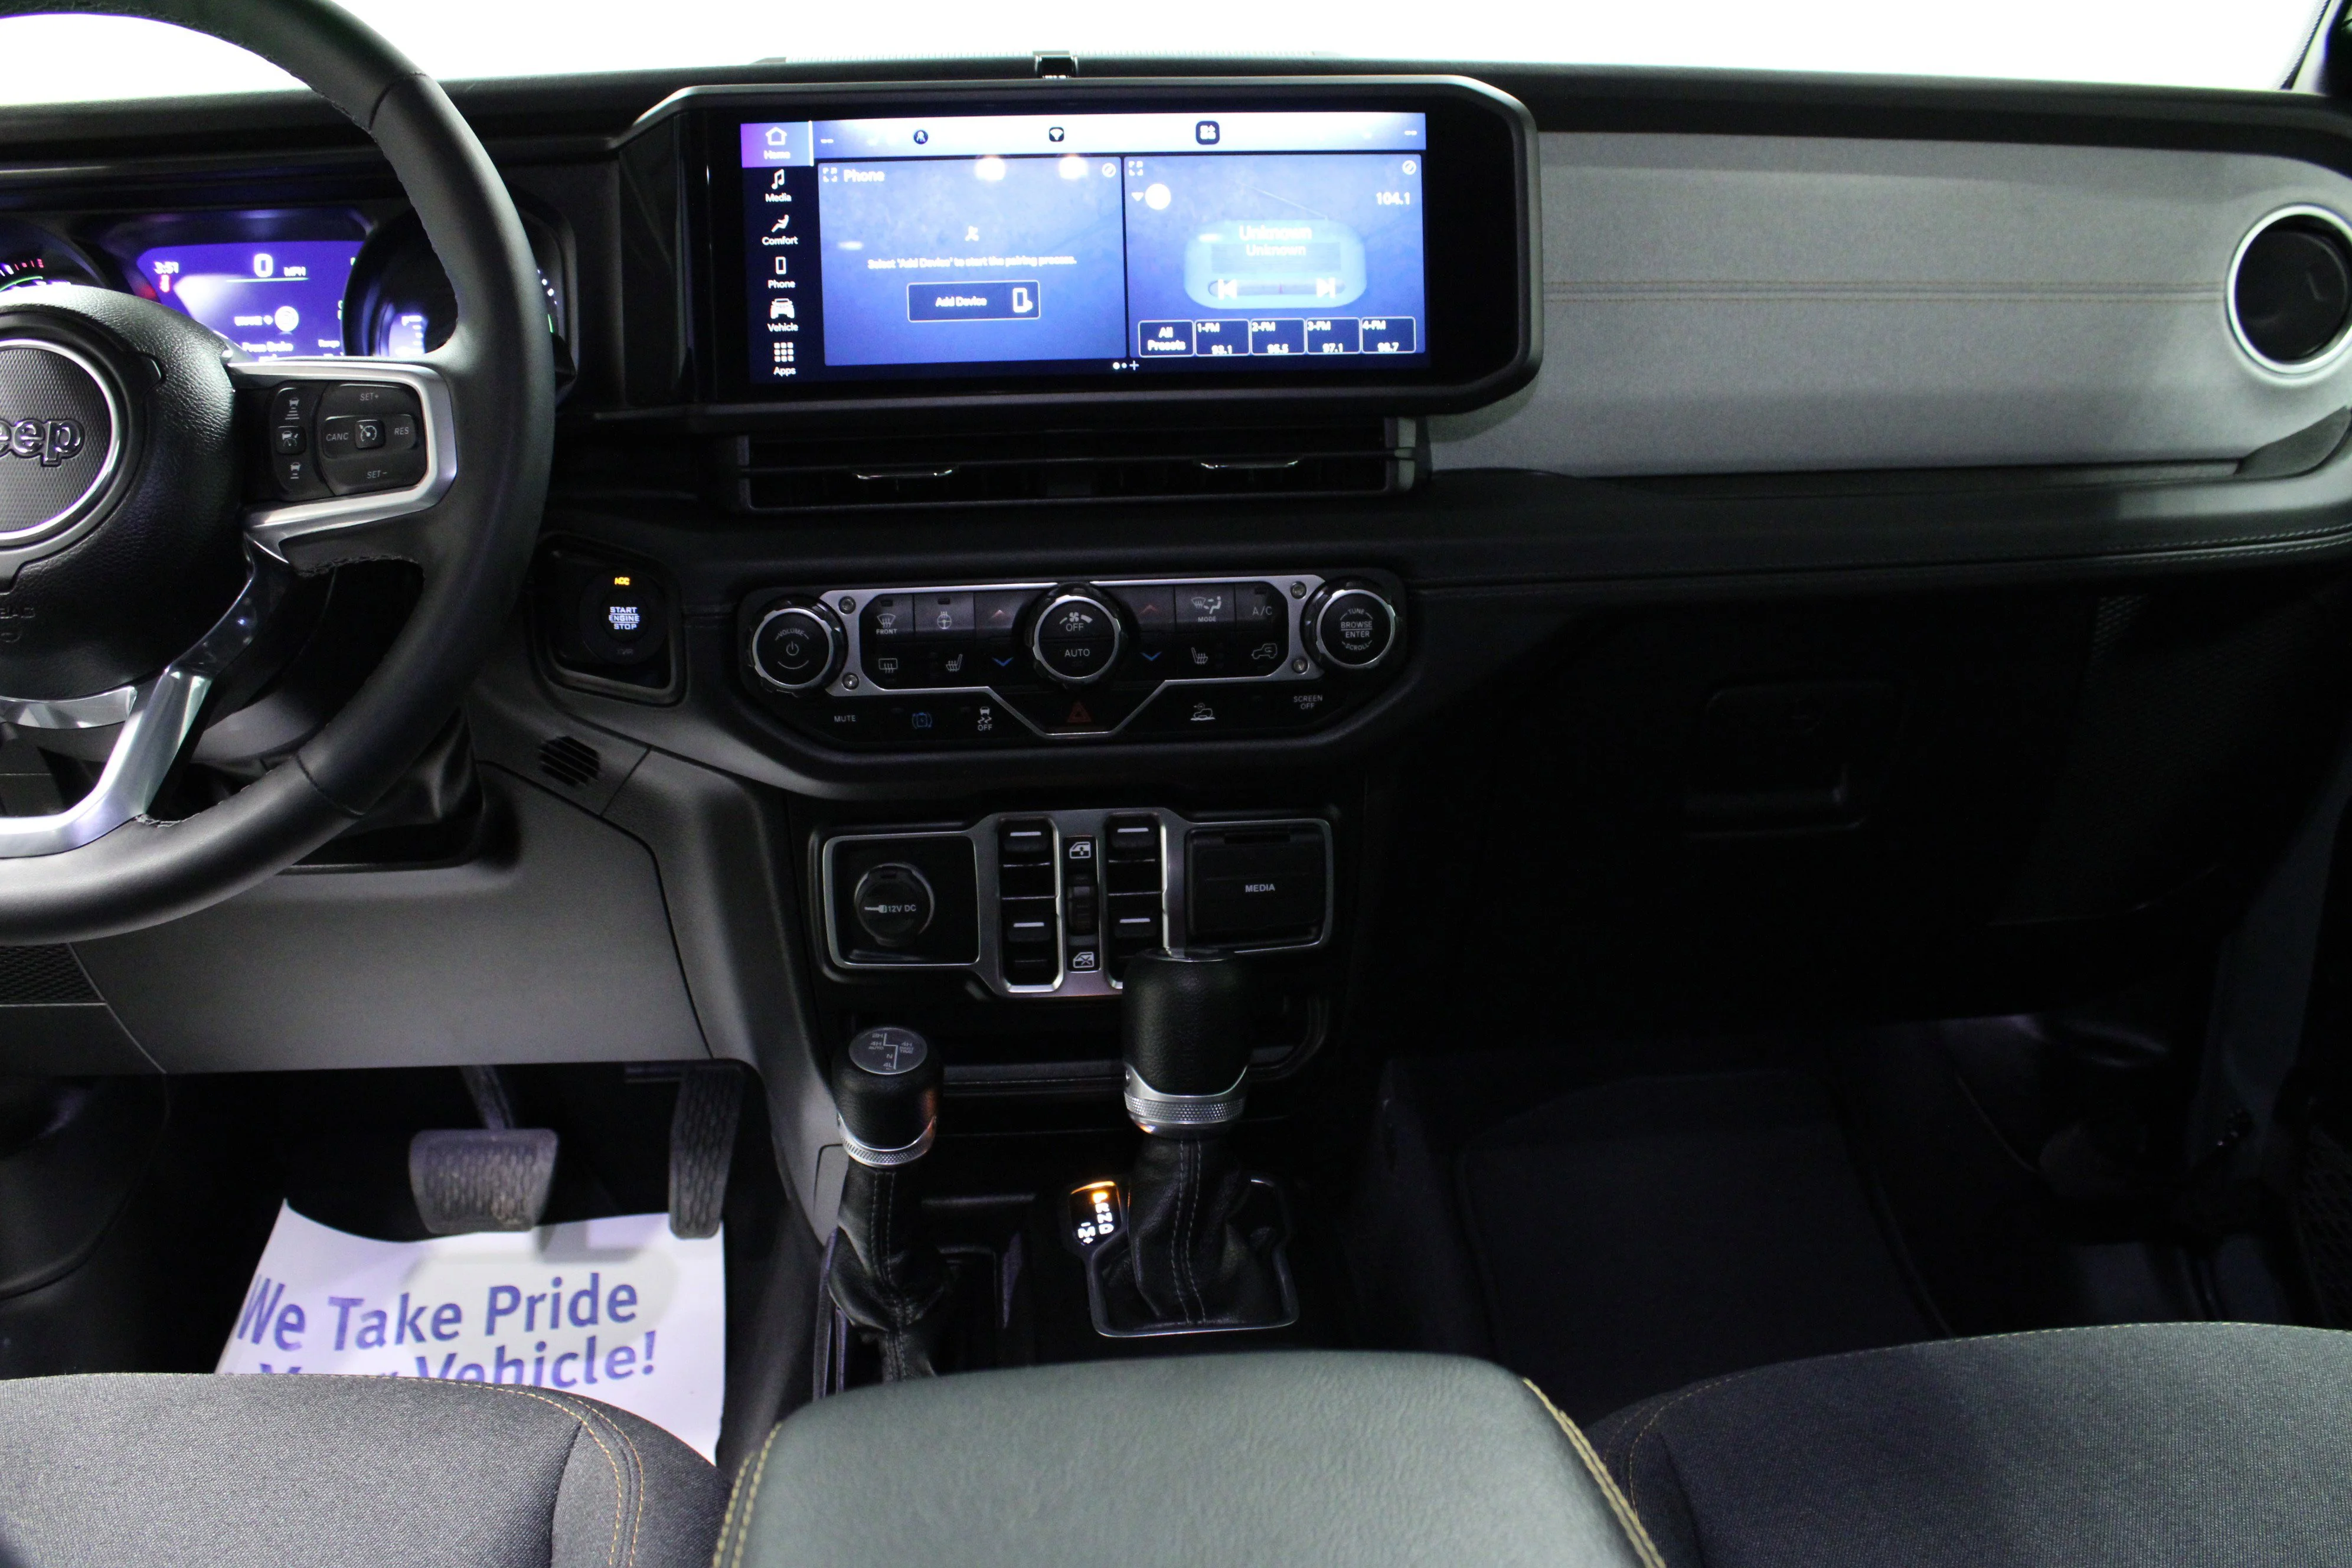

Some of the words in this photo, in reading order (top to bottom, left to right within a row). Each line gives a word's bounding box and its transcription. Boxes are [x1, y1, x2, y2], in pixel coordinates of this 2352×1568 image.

[764, 151, 790, 159] Home
[844, 169, 885, 182] Phone
[765, 192, 792, 202] Media
[1376, 192, 1410, 205] 104.1
[1239, 226, 1312, 240] Unknown
[762, 236, 798, 245] Comfort
[1246, 244, 1306, 256] Unknown
[254, 253, 273, 277] 0
[868, 259, 896, 269] Select
[954, 259, 965, 267] to
[965, 257, 988, 266] start
[988, 256, 1004, 266] the
[1005, 256, 1037, 267] pairing
[768, 280, 795, 289] Phone
[936, 297, 954, 306] Add
[955, 296, 986, 306] Device
[767, 323, 798, 332] Vehicle
[1197, 322, 1220, 333] 1-FM
[1252, 322, 1275, 332] 2-FM
[1307, 321, 1331, 331] 3-FM
[1363, 320, 1386, 331] 4-FM
[1158, 326, 1174, 338] All
[1148, 340, 1186, 351] Presets
[773, 367, 796, 377] Apps
[394, 427, 409, 435] RES
[326, 433, 349, 442] CANC
[615, 577, 630, 585] ACC
[1252, 606, 1273, 616] A/C
[778, 628, 805, 637] VOLUME
[1066, 623, 1084, 632] OFF
[1064, 649, 1090, 657] AUTO
[1245, 884, 1275, 893] MEDIA
[237, 1273, 306, 1351] We
[328, 1292, 462, 1351] Take
[485, 1272, 639, 1337] Pride
